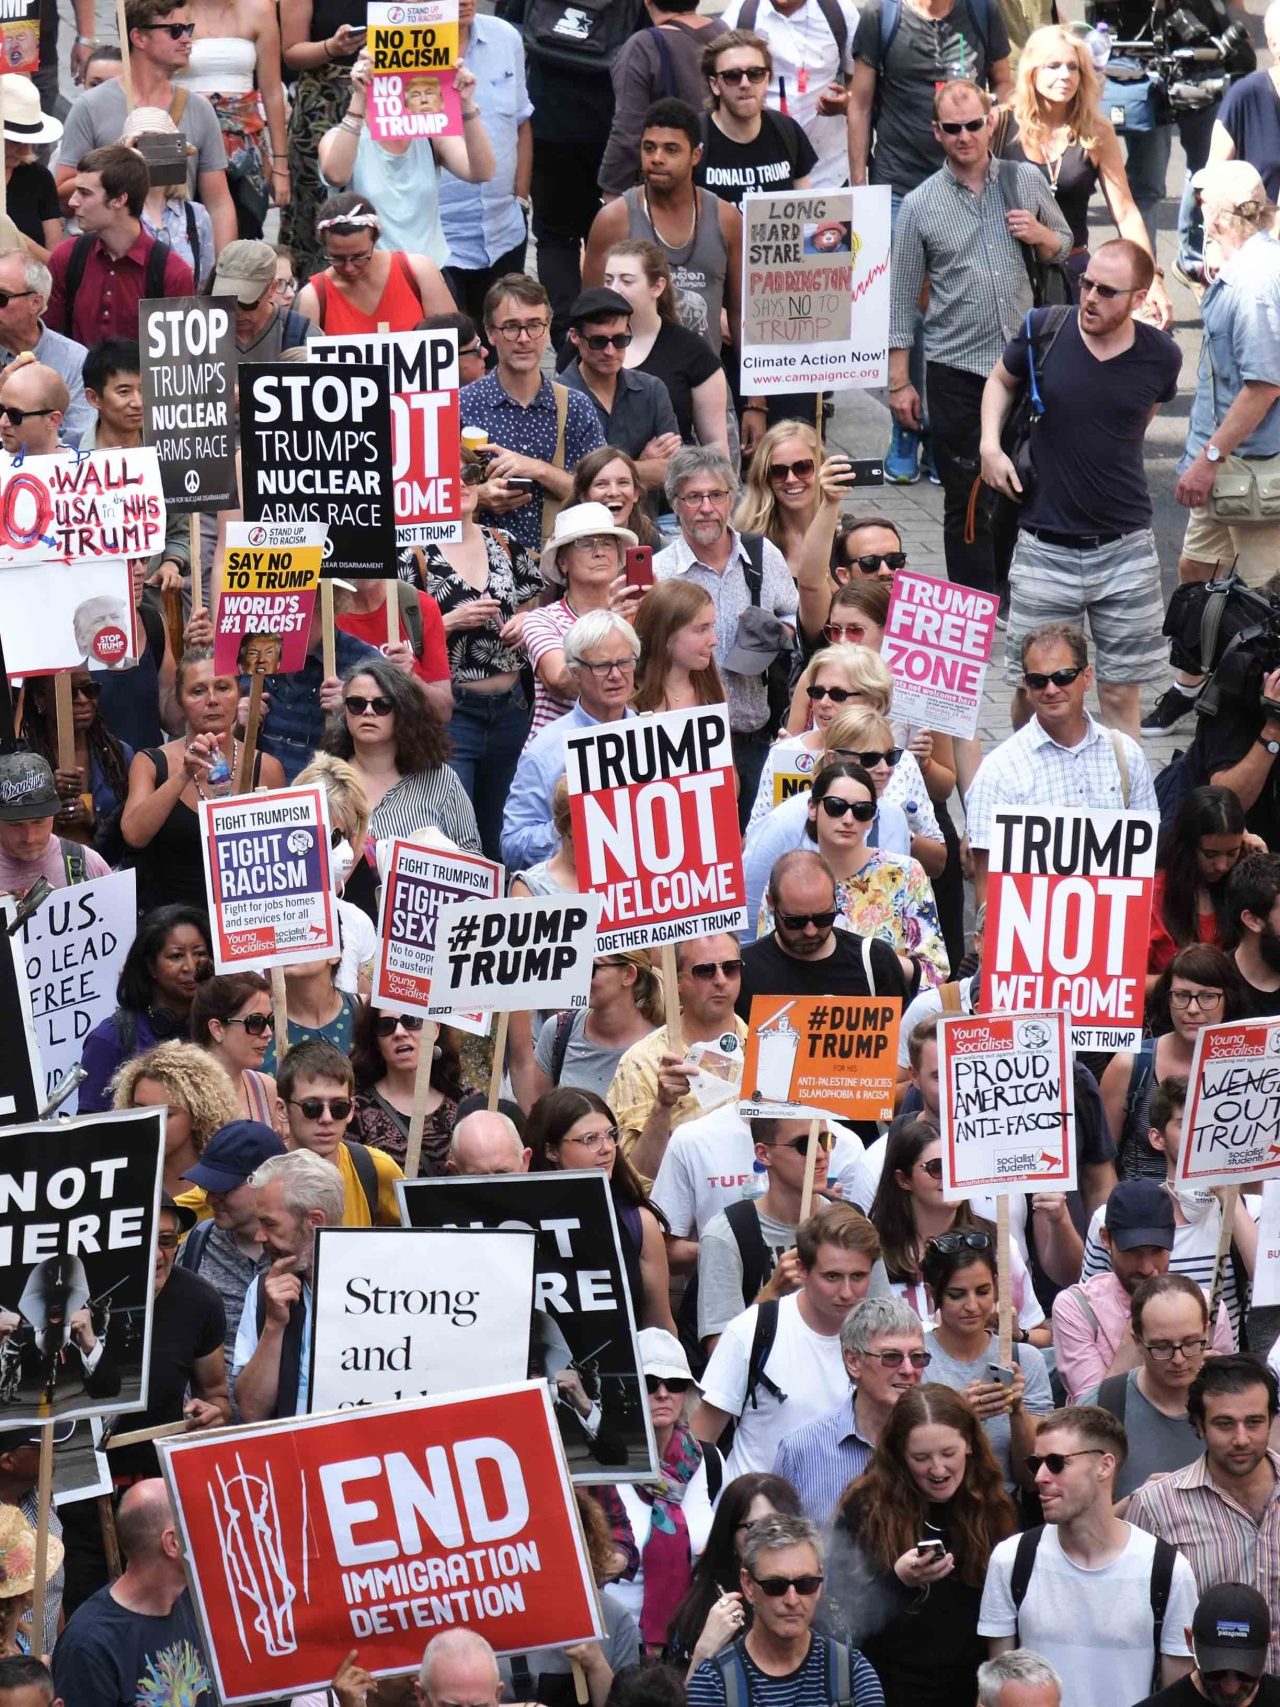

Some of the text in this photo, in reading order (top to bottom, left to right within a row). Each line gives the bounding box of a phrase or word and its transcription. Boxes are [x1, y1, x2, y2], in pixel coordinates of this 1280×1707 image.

[375, 29, 435, 48] NO TO
[375, 48, 449, 68] RACISM
[373, 76, 402, 96] NO
[373, 97, 402, 116] TO
[376, 114, 448, 136] TRUMP
[706, 161, 790, 185] DONALD TRUMP
[769, 201, 826, 219] LONG
[751, 224, 801, 242] HARD
[750, 267, 852, 295] PADDINGTON
[752, 295, 840, 318] SAYS NO TO
[756, 318, 832, 342] TRUMP
[743, 349, 886, 369] Climate Action Now!
[753, 368, 879, 385] www.campaigncc.org
[228, 552, 293, 572] SAY NO
[227, 569, 315, 590] TO TRUMP
[223, 594, 300, 616] WORLD'S
[898, 576, 994, 620] TRUMP
[220, 613, 306, 634] #1 RACIST
[890, 599, 989, 658] FREE
[886, 642, 981, 696] ZONE
[567, 714, 726, 794] TRUMP
[0, 769, 47, 799] Brooklyn
[215, 806, 310, 832] FIGHT TRUMPISM
[582, 770, 725, 885] NOT
[217, 834, 282, 870] FIGHT
[995, 813, 1154, 878] TRUMP
[220, 859, 308, 898] RACISM
[224, 896, 315, 916] Fight for jobs homes
[588, 862, 737, 926] WELCOME
[225, 909, 309, 928] and services for all
[448, 907, 588, 953] #DUMP
[651, 911, 742, 944] AGAINST TRUMP
[995, 877, 1143, 976] NOT
[226, 932, 257, 945] Young
[230, 940, 275, 955] Socialists
[448, 945, 578, 989] TRUMP
[570, 994, 588, 1007] FOA
[990, 974, 1137, 1018] WELCOME
[807, 1005, 895, 1033] #DUMP
[951, 1027, 990, 1040] Young
[1095, 1032, 1136, 1048] TRUMP
[807, 1033, 889, 1060] TRUMP
[956, 1039, 1013, 1054] Socialists
[797, 1076, 893, 1089] ANTI-PALESTINE POLICIES
[955, 1055, 1049, 1091] PROUD
[799, 1089, 890, 1100] ISLAMOPHOBIA & RACISM
[953, 1078, 1060, 1119] AMERICAN
[956, 1112, 1073, 1143] ANTI-FASCIST
[997, 1154, 1034, 1165] socialist
[997, 1162, 1038, 1173] students
[344, 1275, 481, 1328] Strong
[339, 1336, 413, 1372] and
[318, 1436, 531, 1568] END
[340, 1540, 542, 1605] IMMIGRATION
[350, 1580, 527, 1639] DETENTION
